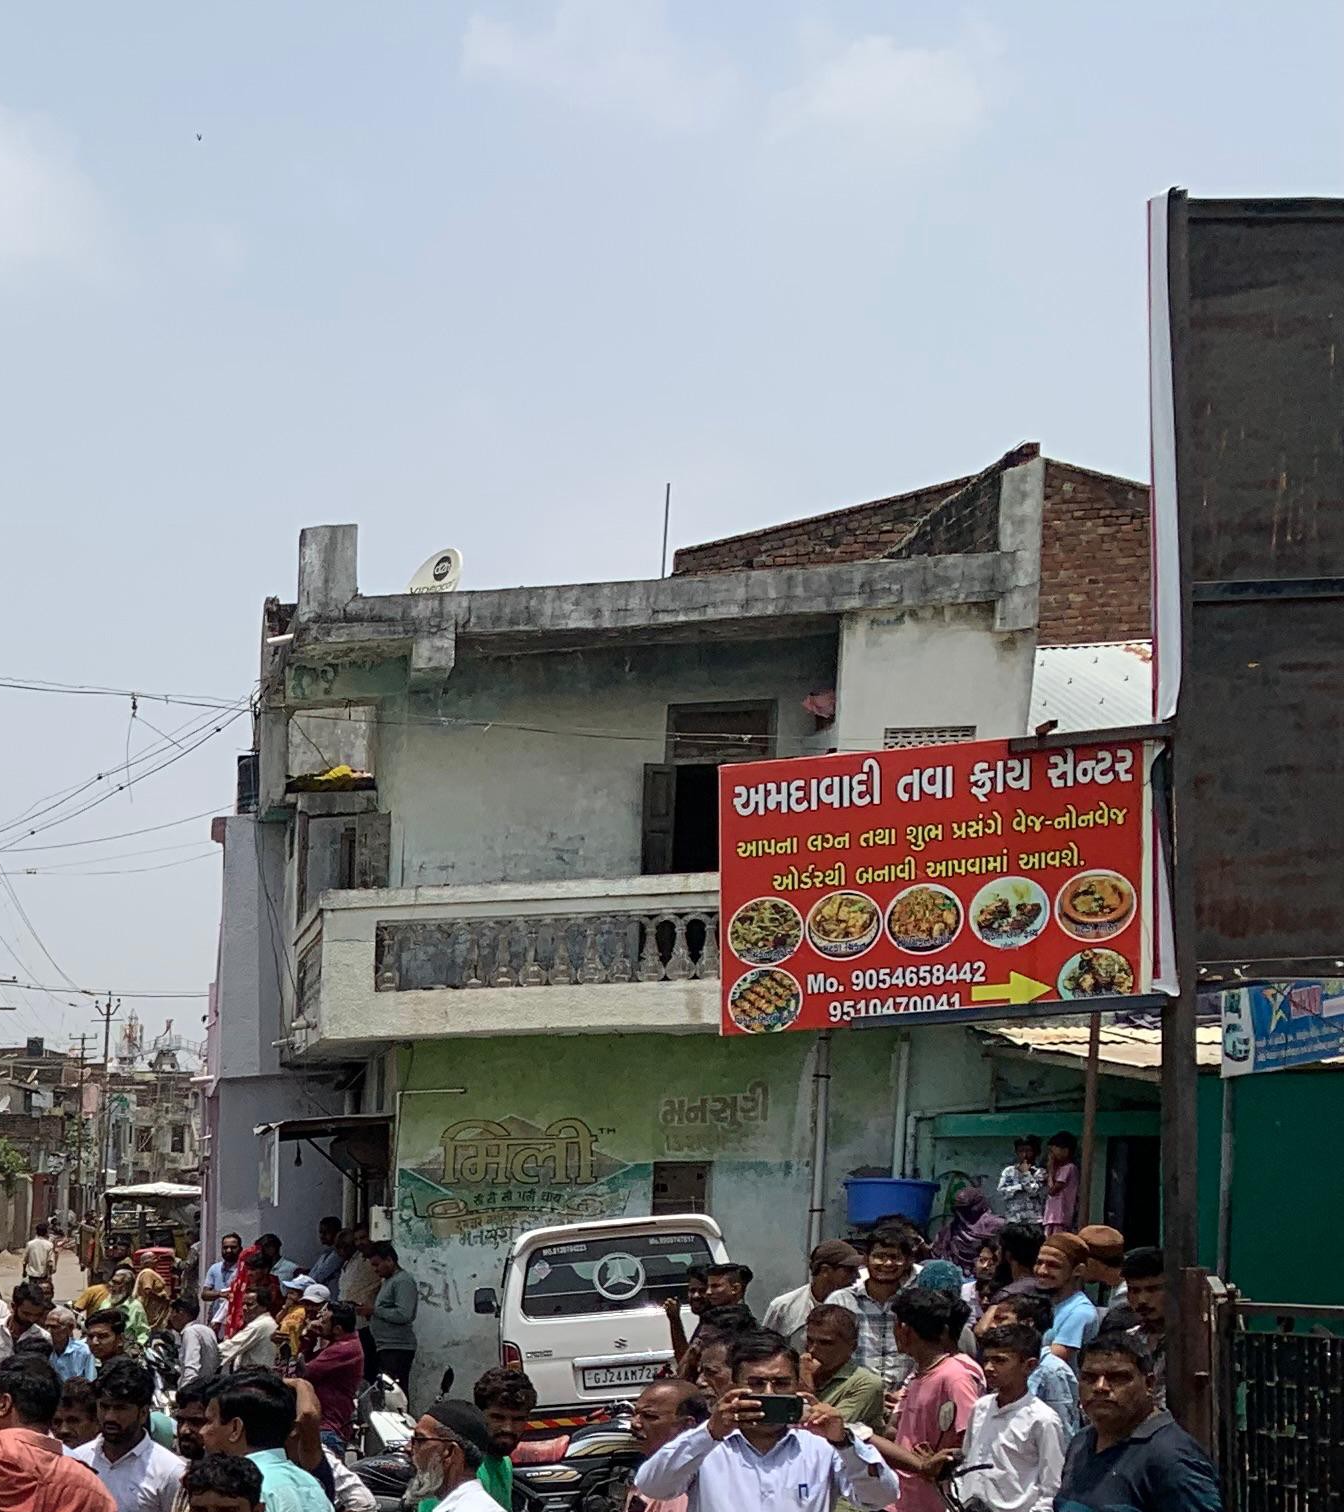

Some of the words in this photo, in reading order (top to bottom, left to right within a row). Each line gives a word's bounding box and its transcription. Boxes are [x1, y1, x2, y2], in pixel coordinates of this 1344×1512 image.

[732, 757, 881, 816] અમદાવાદી
[896, 766, 953, 801] તવા
[969, 757, 1031, 802] ફ્રાય
[1047, 748, 1133, 788] સેન્ટર
[736, 836, 798, 858] આપના
[807, 831, 850, 851] લગ્ન
[859, 828, 896, 847] તથા
[906, 823, 943, 851] શુભ
[952, 811, 1002, 839] પ્રસંગે
[1012, 801, 1128, 834] વેજ-નોનવેજ
[855, 856, 916, 885] બનાવી
[926, 848, 1008, 878] આપવામાં
[1018, 842, 1085, 870] આવશે.
[807, 973, 844, 994] Mo.
[851, 960, 986, 991] 9054658442
[829, 992, 961, 1022] 9510470041
